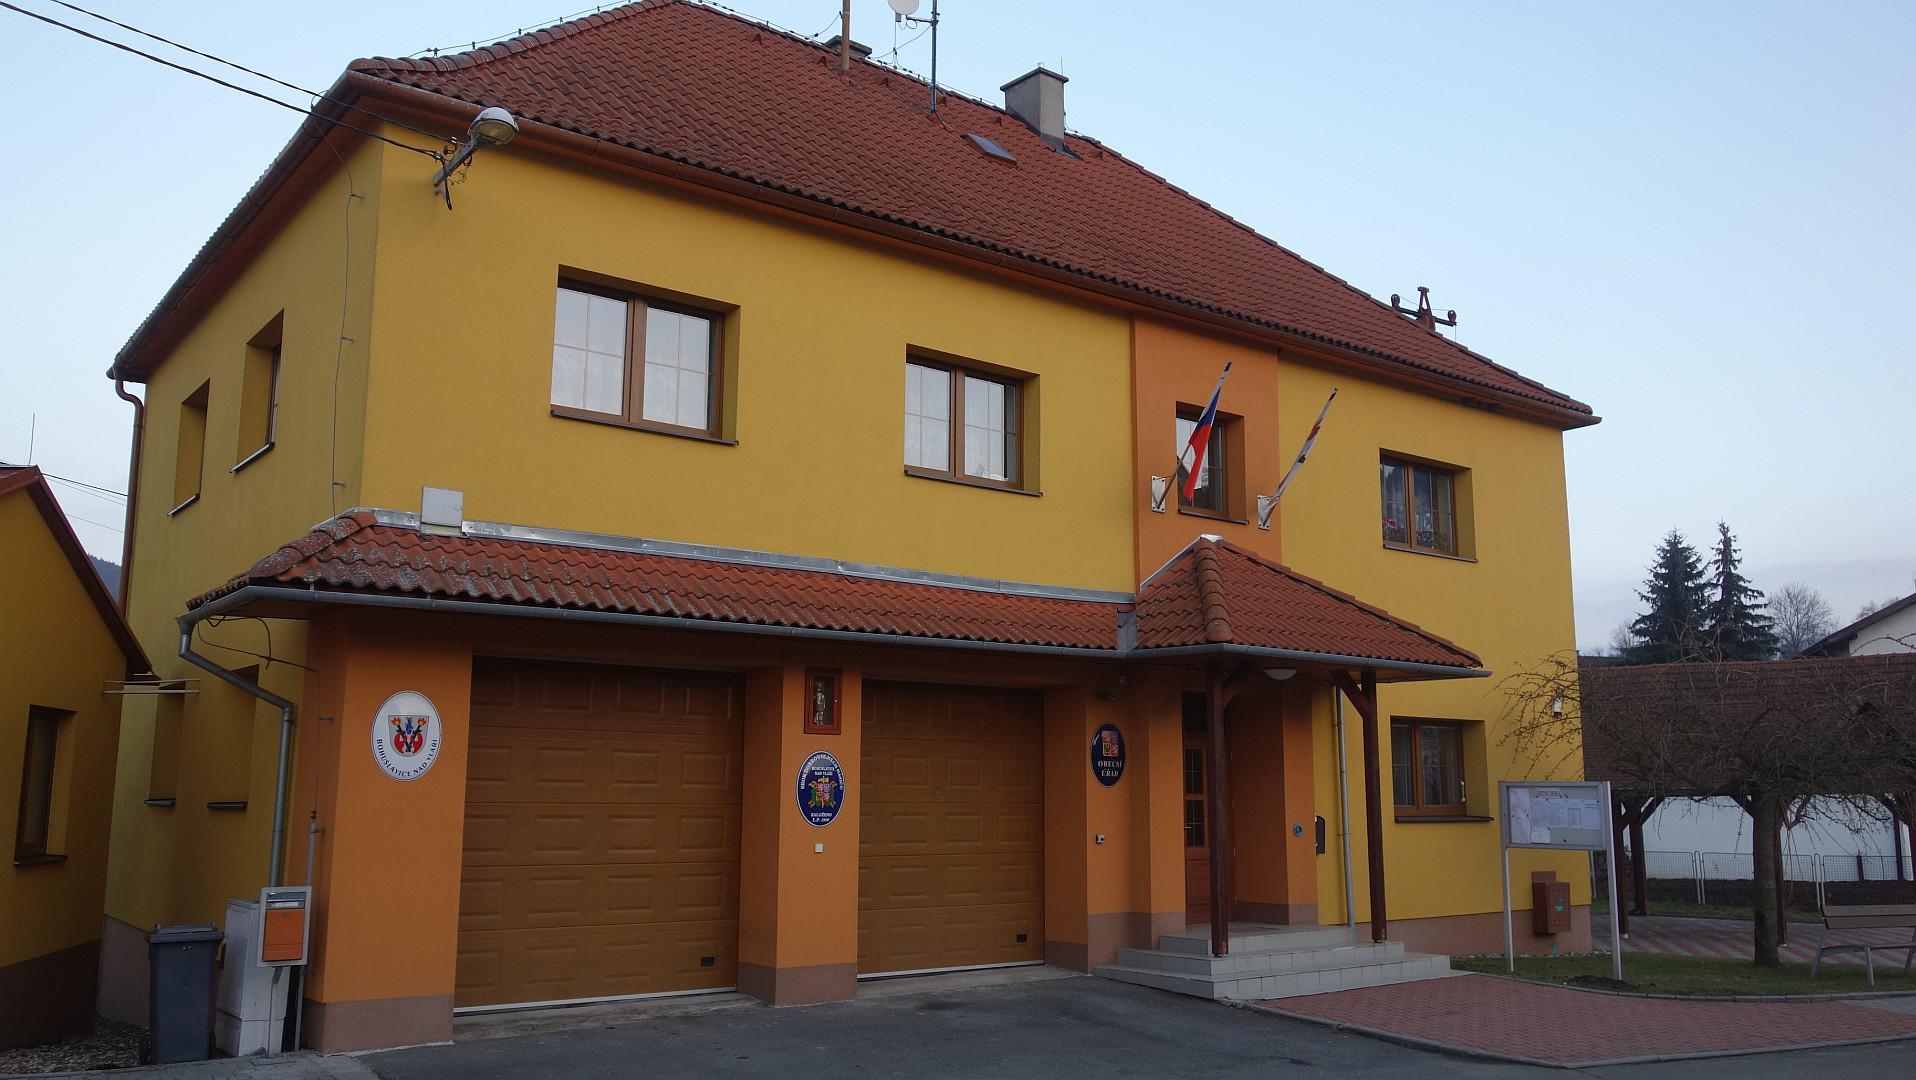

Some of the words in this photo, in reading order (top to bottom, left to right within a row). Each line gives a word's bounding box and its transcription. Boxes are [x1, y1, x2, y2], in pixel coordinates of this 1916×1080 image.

[376, 738, 412, 777] BOHUSLAVICE
[413, 762, 428, 774] NAD
[1098, 760, 1122, 768] OBECNÍ
